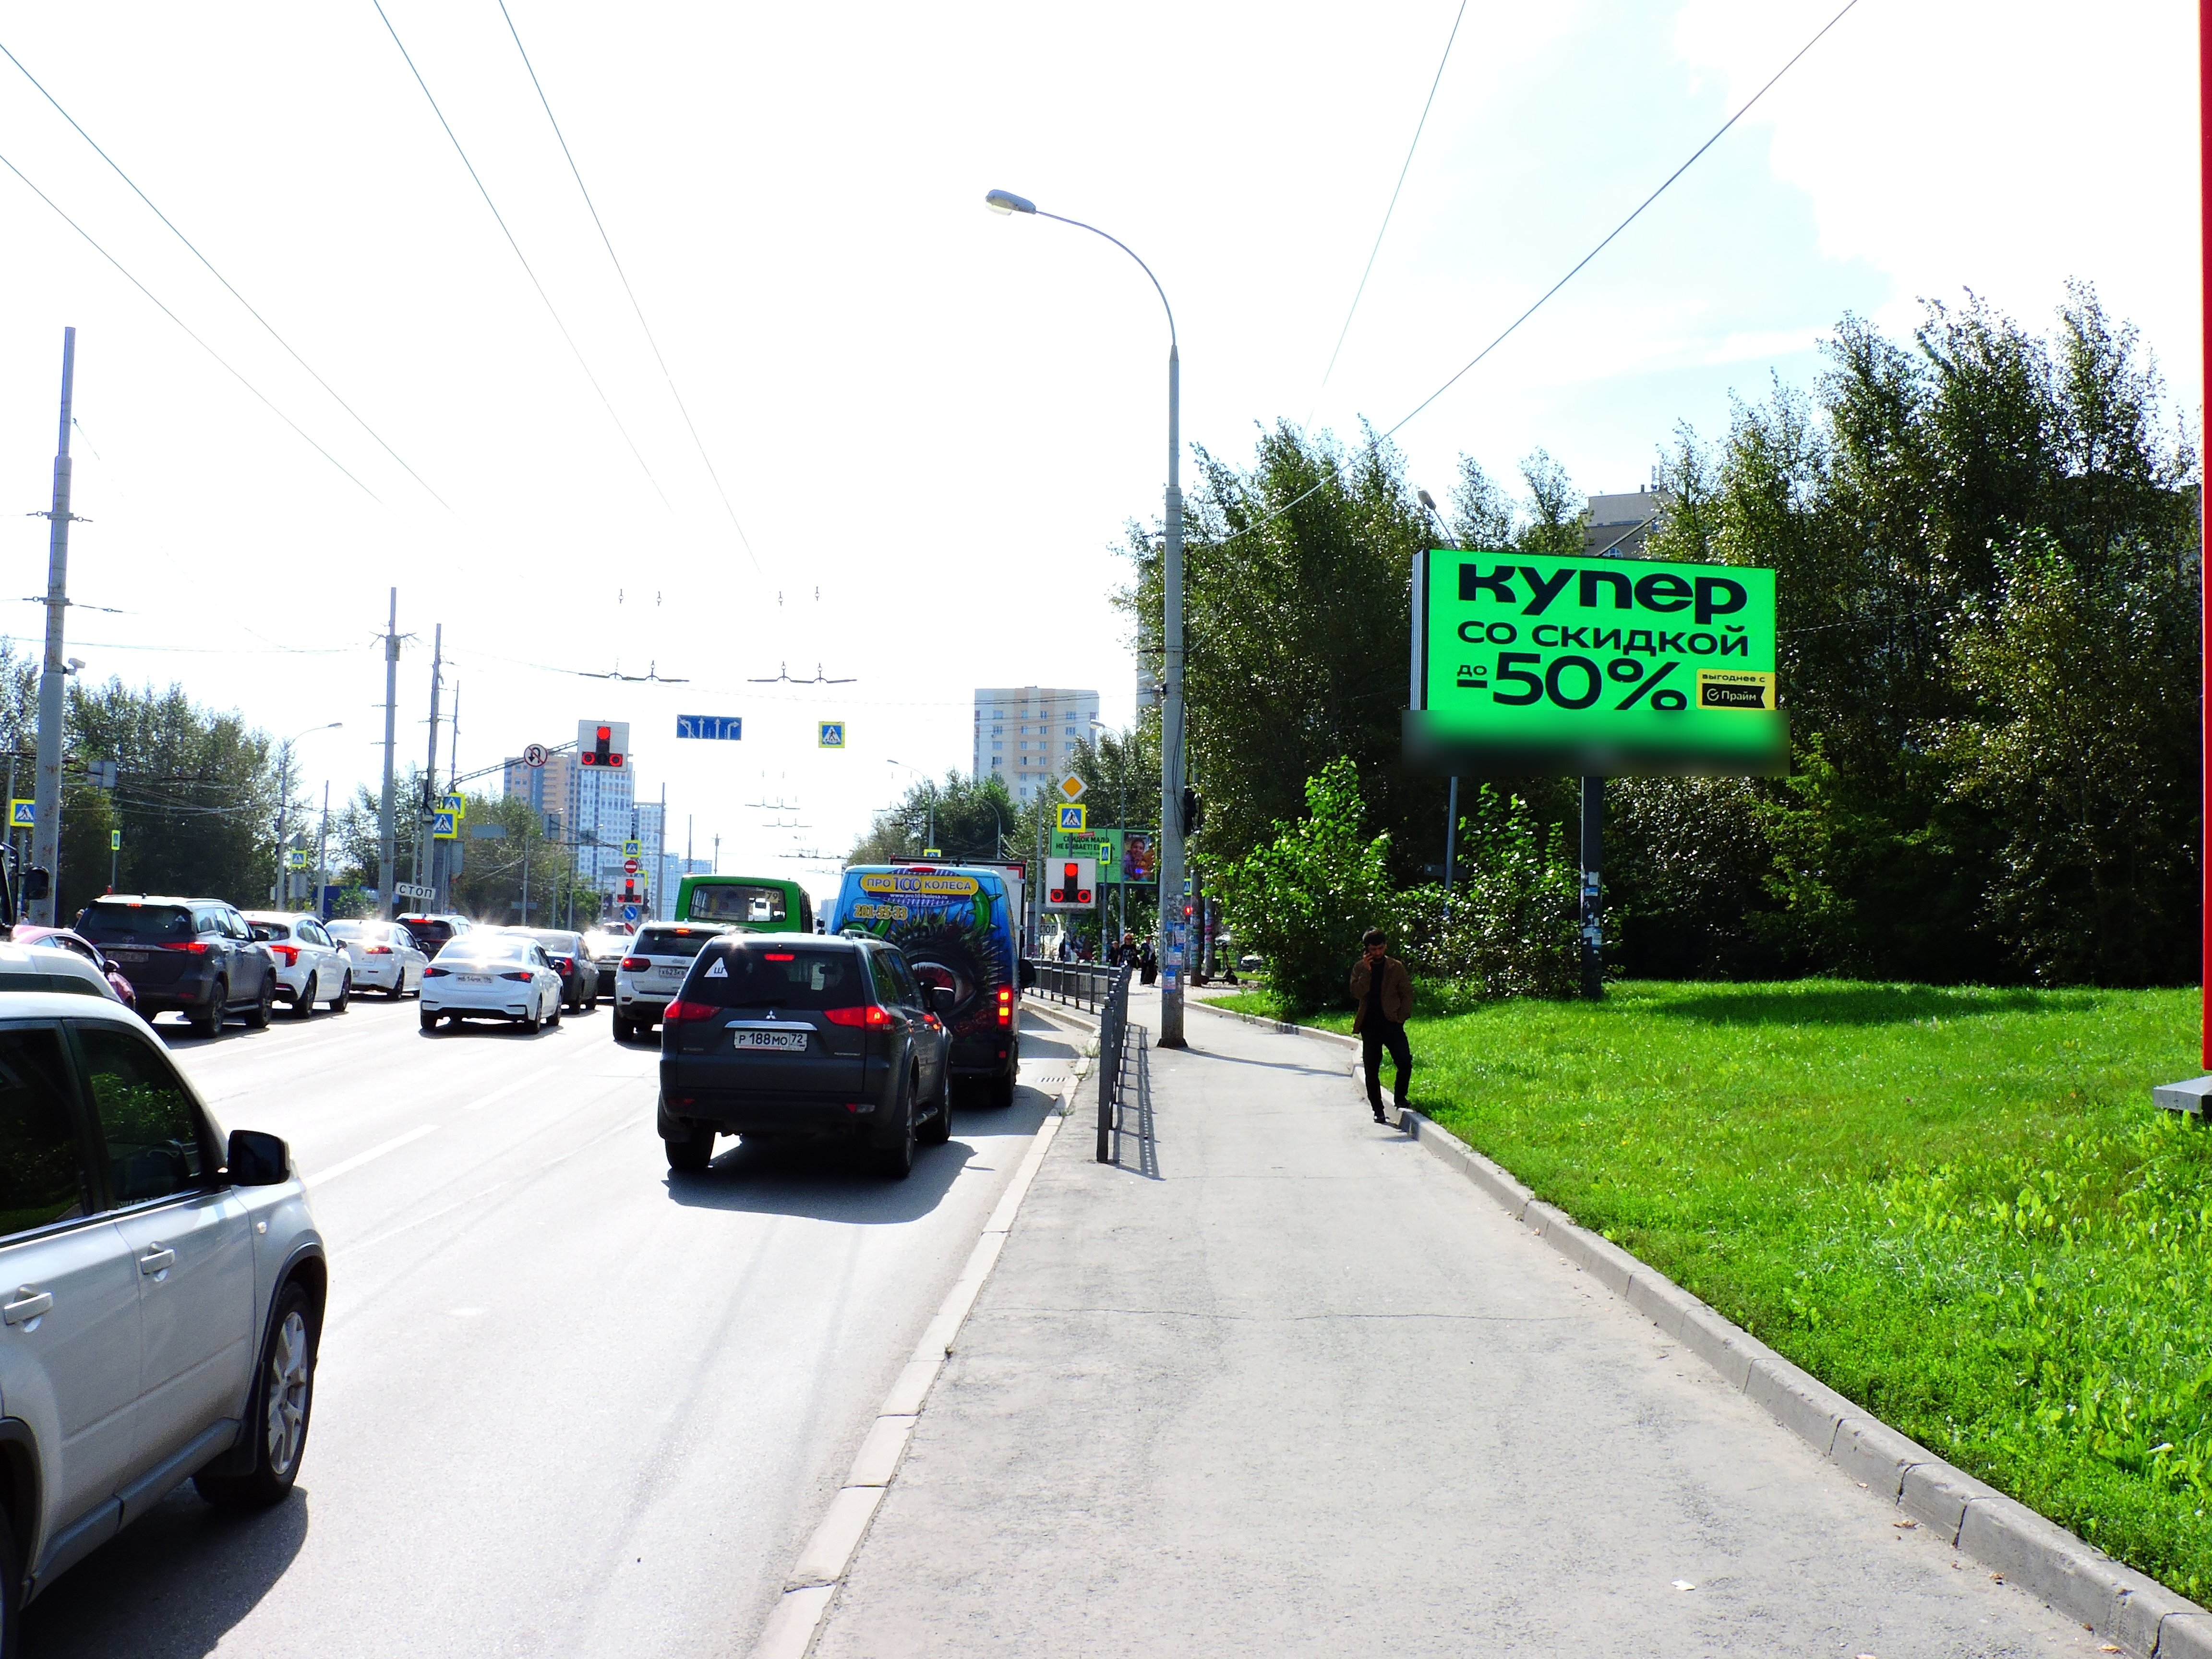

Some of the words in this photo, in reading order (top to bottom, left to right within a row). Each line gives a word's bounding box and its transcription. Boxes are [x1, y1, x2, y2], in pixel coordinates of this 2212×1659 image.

[1457, 621, 1517, 645] со
[1532, 625, 1748, 657] скидкой
[1457, 665, 1487, 677] до
[1702, 674, 1756, 682] выгоднее
[1721, 690, 1756, 702] Прайм
[867, 878, 890, 887] ПРО
[893, 877, 921, 891] 100
[925, 881, 972, 890] КОЛЕСА
[399, 885, 432, 898] СТОП
[854, 904, 908, 920] 201-55-33
